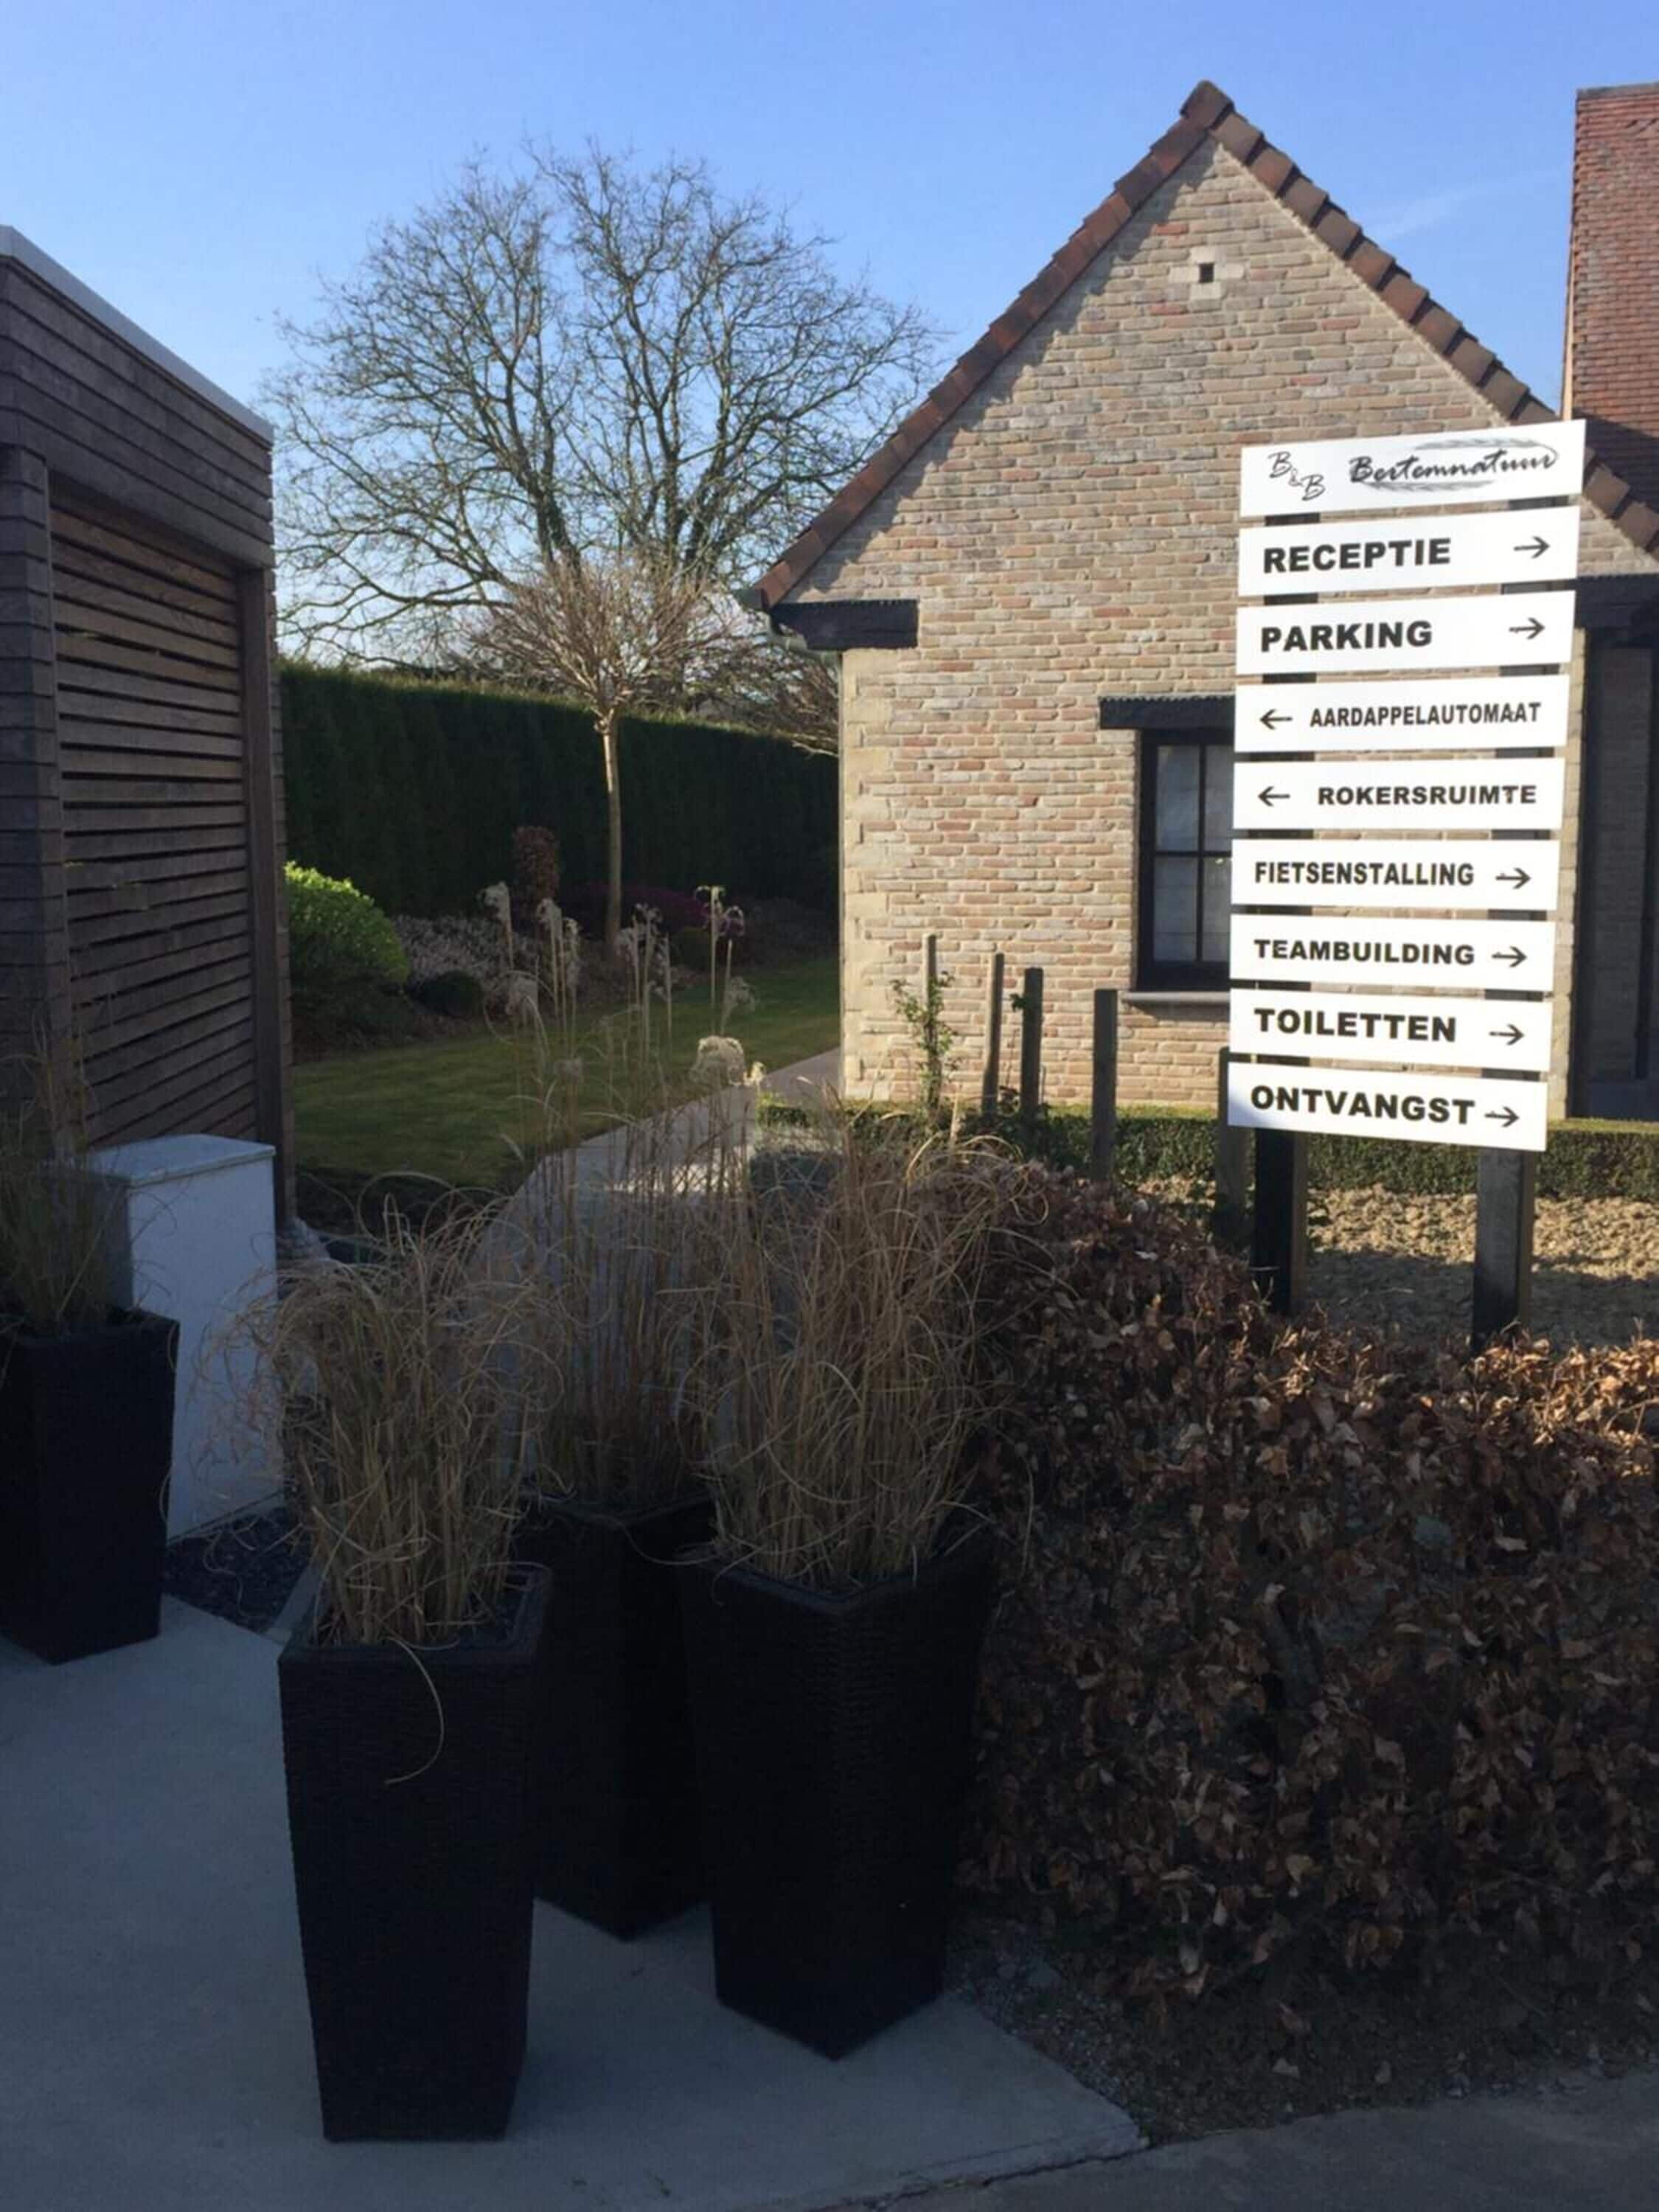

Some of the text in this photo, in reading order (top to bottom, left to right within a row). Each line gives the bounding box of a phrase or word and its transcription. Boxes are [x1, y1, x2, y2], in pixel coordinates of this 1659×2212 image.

[1349, 448, 1554, 482] Bertemnatuur
[1263, 538, 1450, 574] RECEPTIE
[1262, 620, 1432, 653] PARKING
[1310, 702, 1541, 727] AARDAPPELAUTOMAAT
[1318, 785, 1537, 805] ROKERSRUIMTE
[1255, 861, 1474, 886] FIETSENSTALLING
[1254, 939, 1475, 965] TEAMBUILDING
[1254, 1008, 1456, 1042] TOILETTEN
[1251, 1085, 1475, 1124] ONTVANGST
